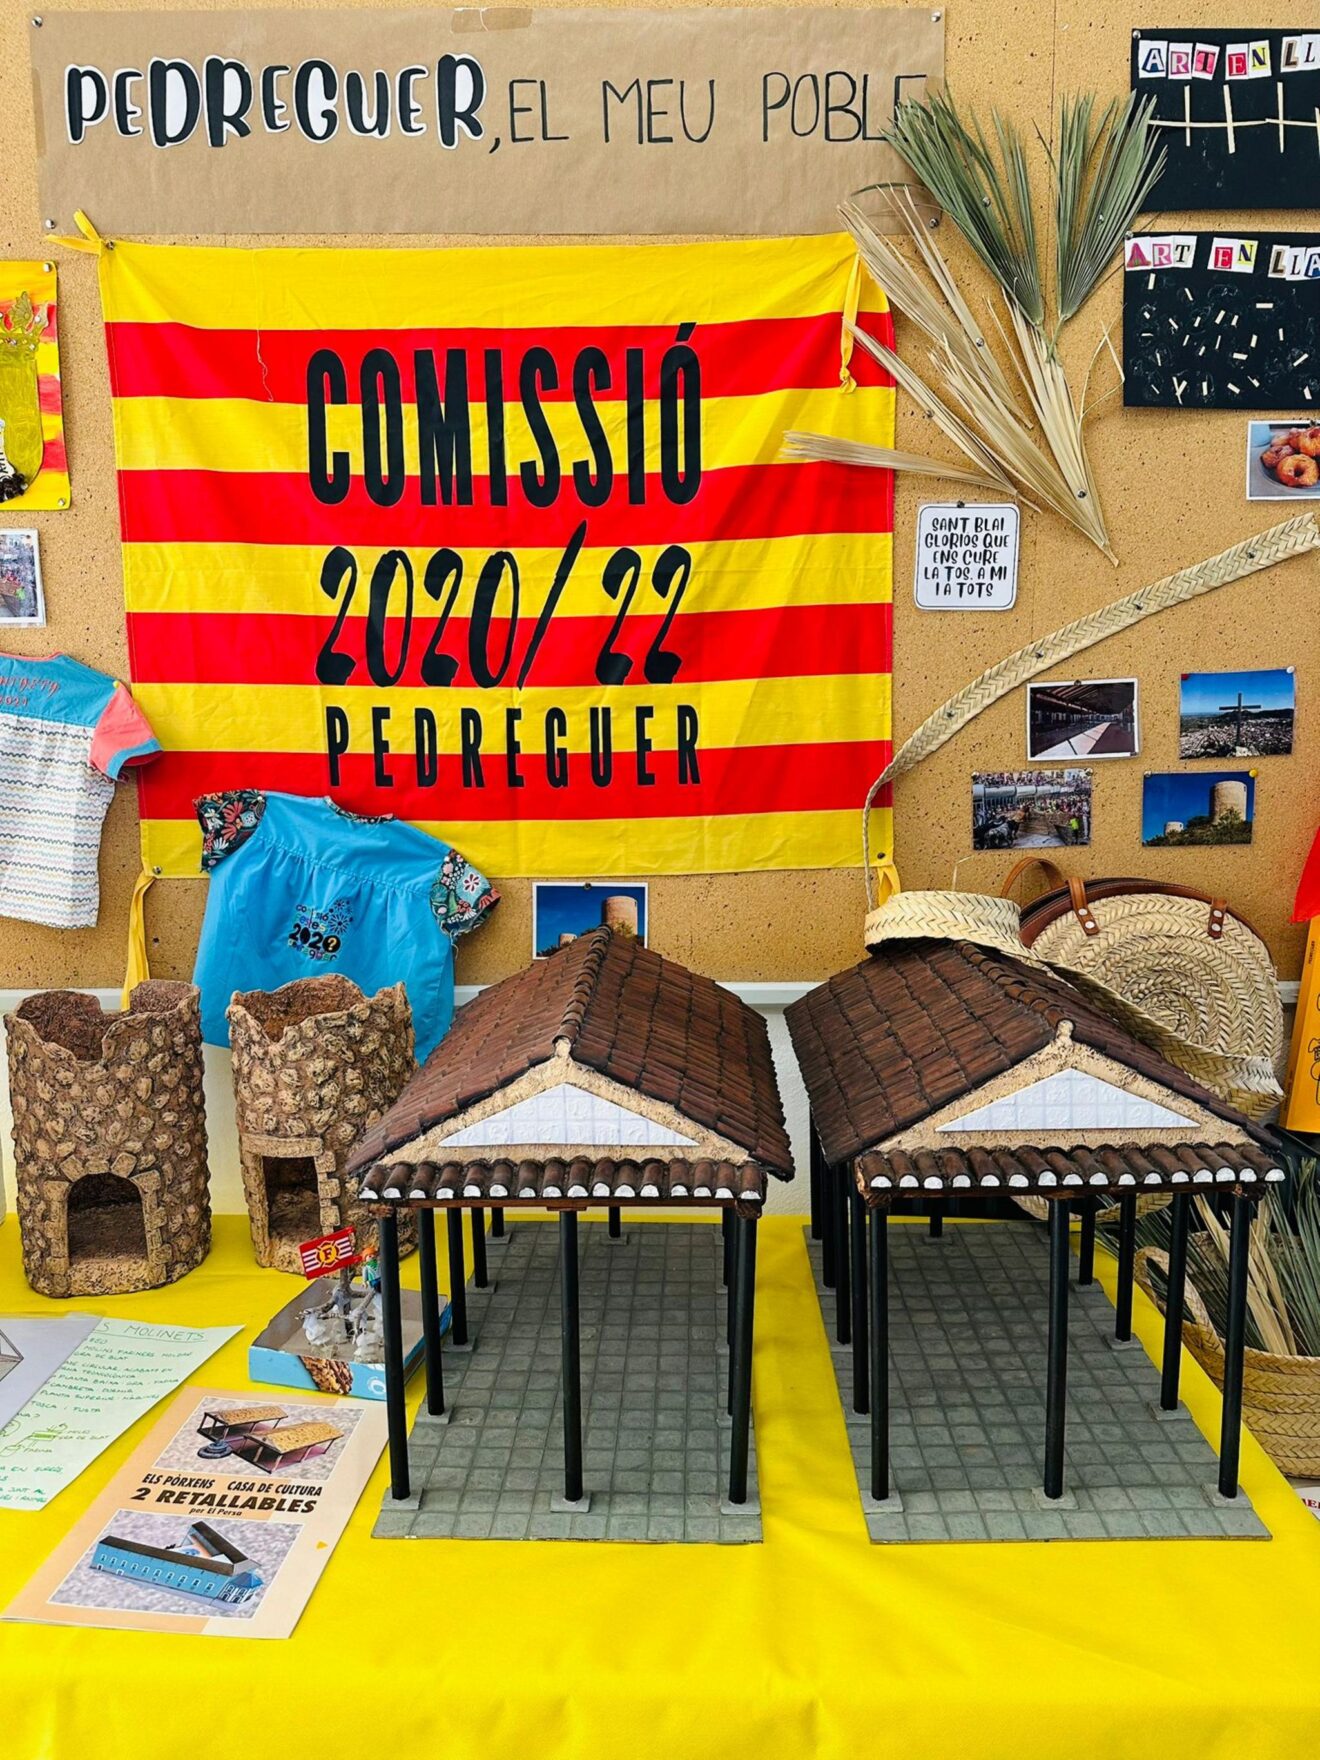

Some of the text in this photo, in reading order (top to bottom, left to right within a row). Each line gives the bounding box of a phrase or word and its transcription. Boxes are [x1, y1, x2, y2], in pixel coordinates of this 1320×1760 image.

[1142, 47, 1216, 75] ART
[1228, 46, 1266, 76] EN
[508, 79, 569, 143] EL
[602, 79, 715, 144] MEU
[1127, 242, 1191, 268] ART
[1214, 243, 1253, 269] EN
[305, 322, 702, 507] COMISSIÓ
[932, 517, 1005, 533] SANT BLAI
[924, 532, 1010, 549] GLORIOS QUE
[933, 549, 1000, 566] ENS CURE
[924, 566, 939, 580] LA
[977, 567, 986, 579] A
[990, 566, 1007, 581] MI
[943, 583, 952, 596] A
[957, 582, 994, 598] TOTS
[326, 704, 702, 788] PEDREGUER
[142, 1473, 163, 1484] ELS
[227, 1480, 256, 1493] CASA
[256, 1483, 273, 1493] DE
[274, 1484, 323, 1497] CULTURA
[130, 1487, 318, 1514] 2 RETALLABLES
[188, 1507, 205, 1515] per
[217, 1508, 243, 1517] Persa
